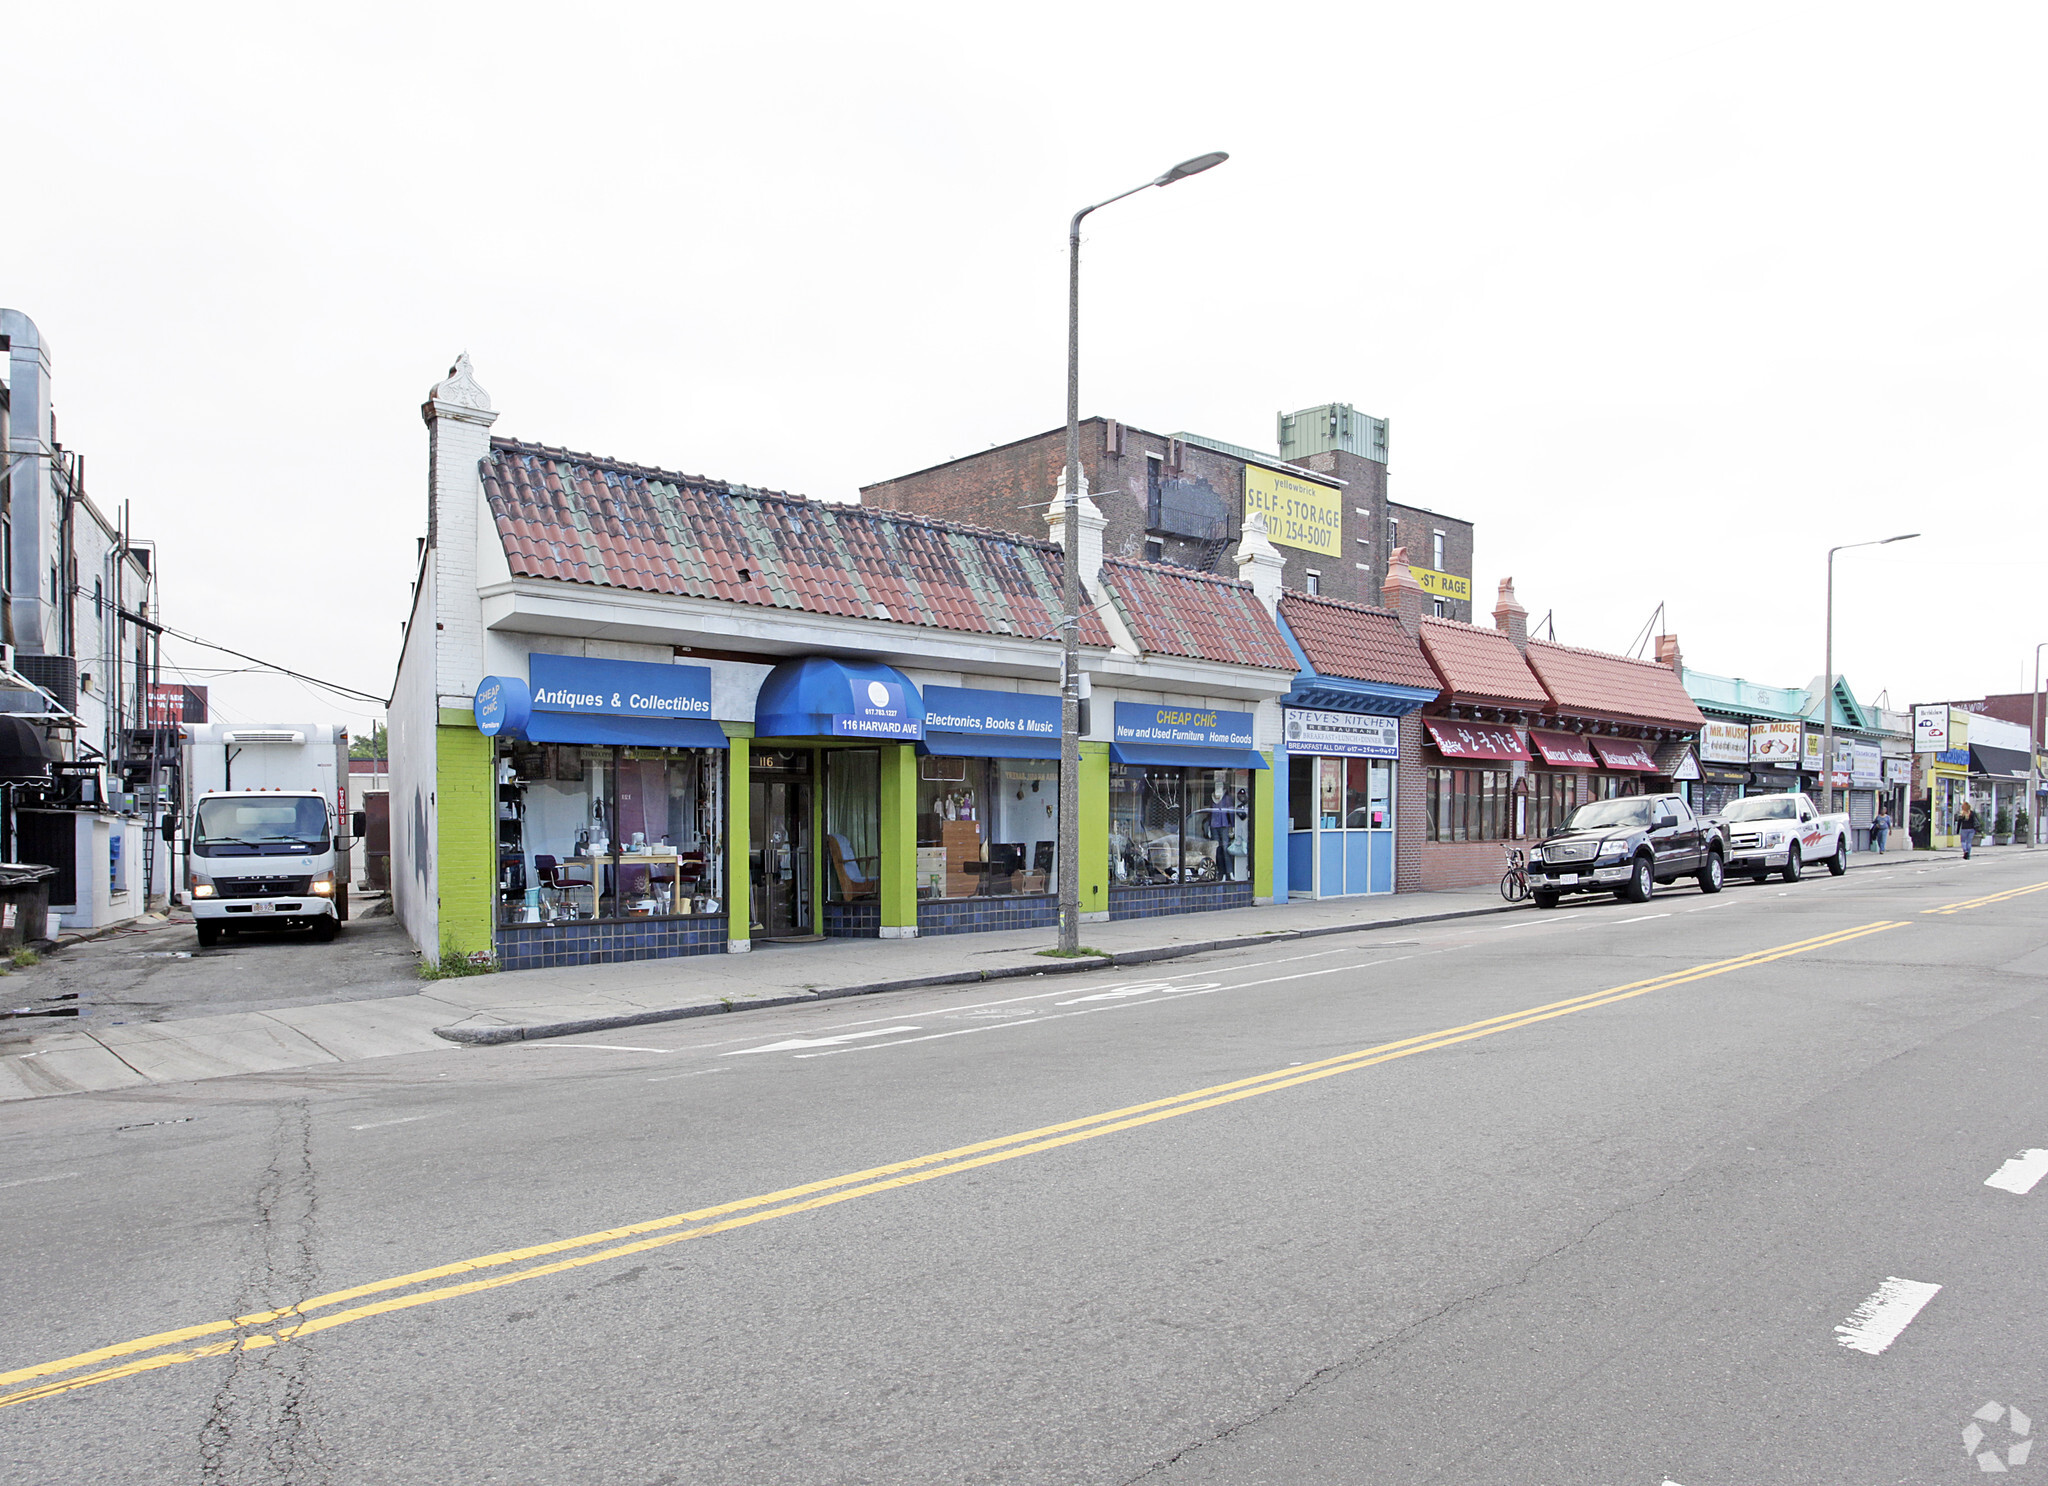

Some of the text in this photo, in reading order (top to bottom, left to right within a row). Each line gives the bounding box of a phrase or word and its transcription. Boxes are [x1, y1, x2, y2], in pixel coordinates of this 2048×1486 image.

[1275, 479, 1316, 496] yellowbrick
[1248, 489, 1339, 528] SELF-STORAGE
[1286, 519, 1331, 547] 254-5007
[1442, 577, 1466, 594] RAGE
[478, 684, 500, 703] CHEAP
[534, 688, 709, 712] Antiques & Collectibles
[925, 712, 1053, 732] Electronics, Books & Music
[1156, 710, 1192, 725] CHEAP
[1289, 711, 1395, 728] STEVE'S KITCHEN
[842, 720, 917, 734] 116 HARVARD AVE
[1117, 725, 1252, 744] New and Used Furniture Home Goods
[1309, 725, 1378, 735] RESTAURANT
[1710, 724, 1747, 739] MR. MUSIC
[1751, 723, 1800, 735] MR. MUSIC
[1288, 742, 1323, 751] BREAKFAST
[1541, 746, 1594, 763] Korean Garden
[760, 756, 773, 767] 116
[1601, 750, 1638, 766] Restaurant
